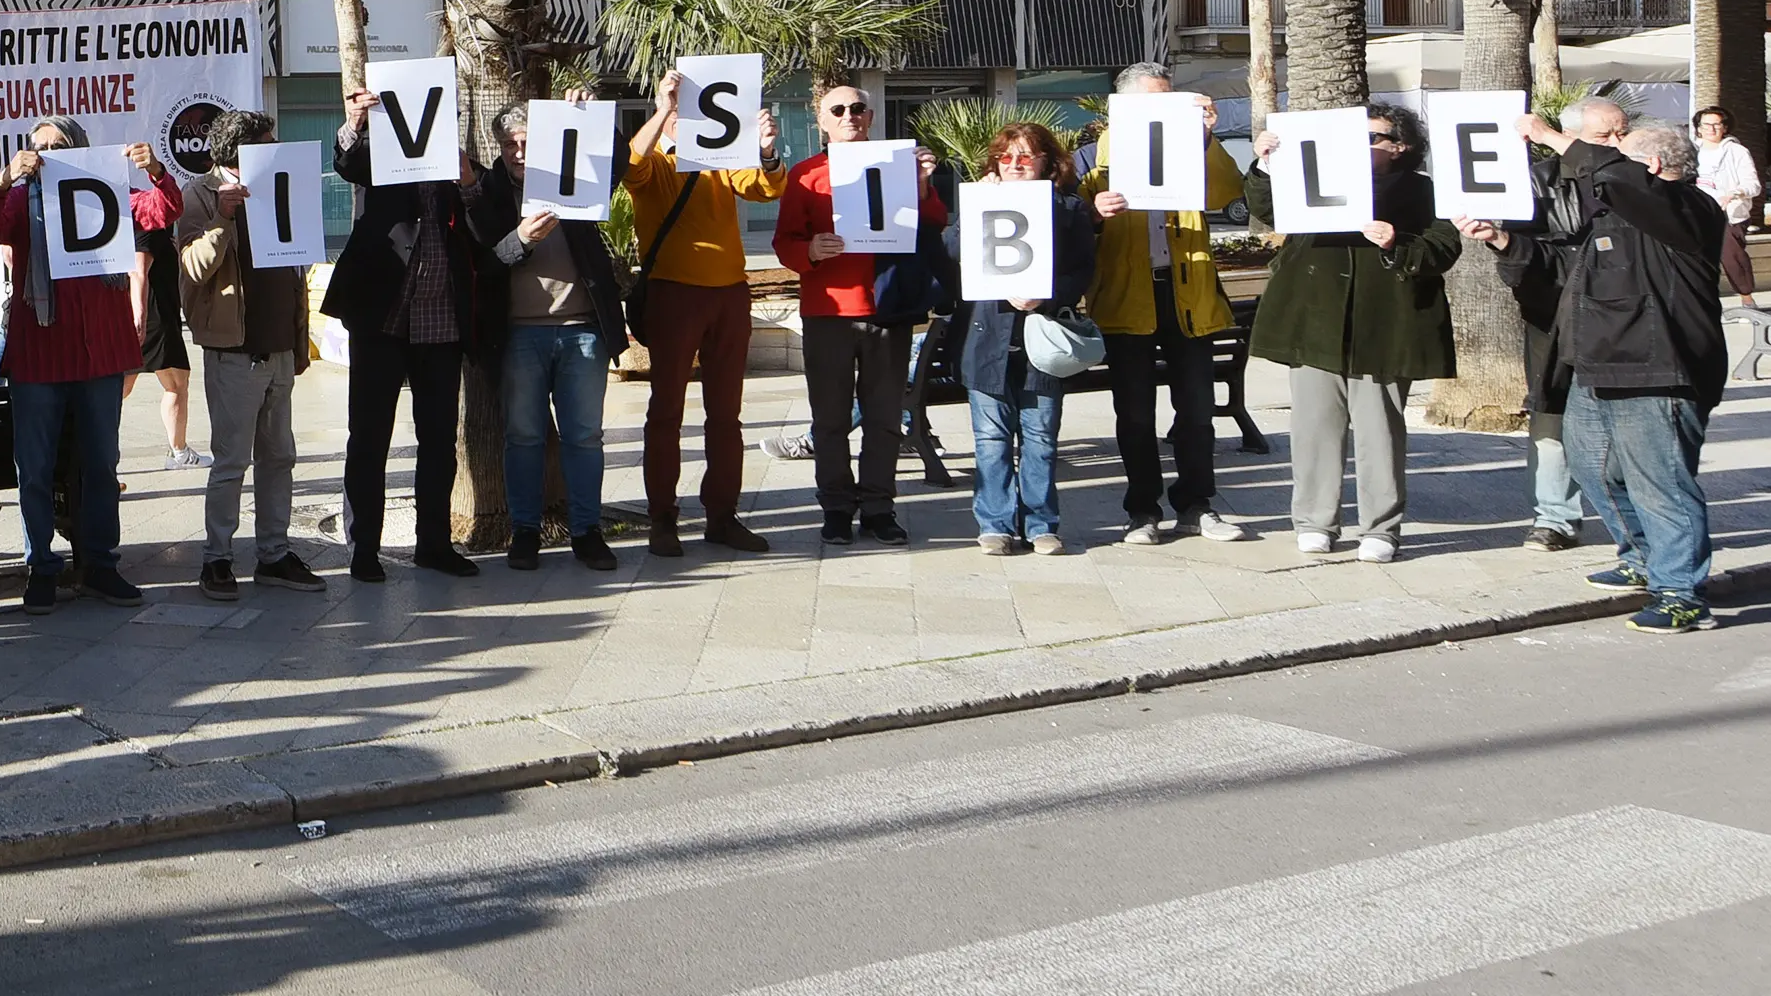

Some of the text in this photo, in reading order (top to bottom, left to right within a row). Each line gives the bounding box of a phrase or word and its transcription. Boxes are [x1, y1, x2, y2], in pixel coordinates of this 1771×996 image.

[74, 26, 89, 62] E
[96, 17, 248, 62] L'ECONOMIA
[175, 123, 211, 136] TAVO
[210, 94, 238, 112] L'UNIT
[380, 87, 443, 158] V
[697, 82, 741, 148] S
[559, 129, 577, 196] I
[1149, 121, 1164, 186] I
[1300, 140, 1347, 208] L
[1456, 123, 1506, 192] E
[57, 177, 120, 253] D
[275, 171, 293, 243] I
[866, 168, 884, 231] I
[982, 210, 1034, 275] B
